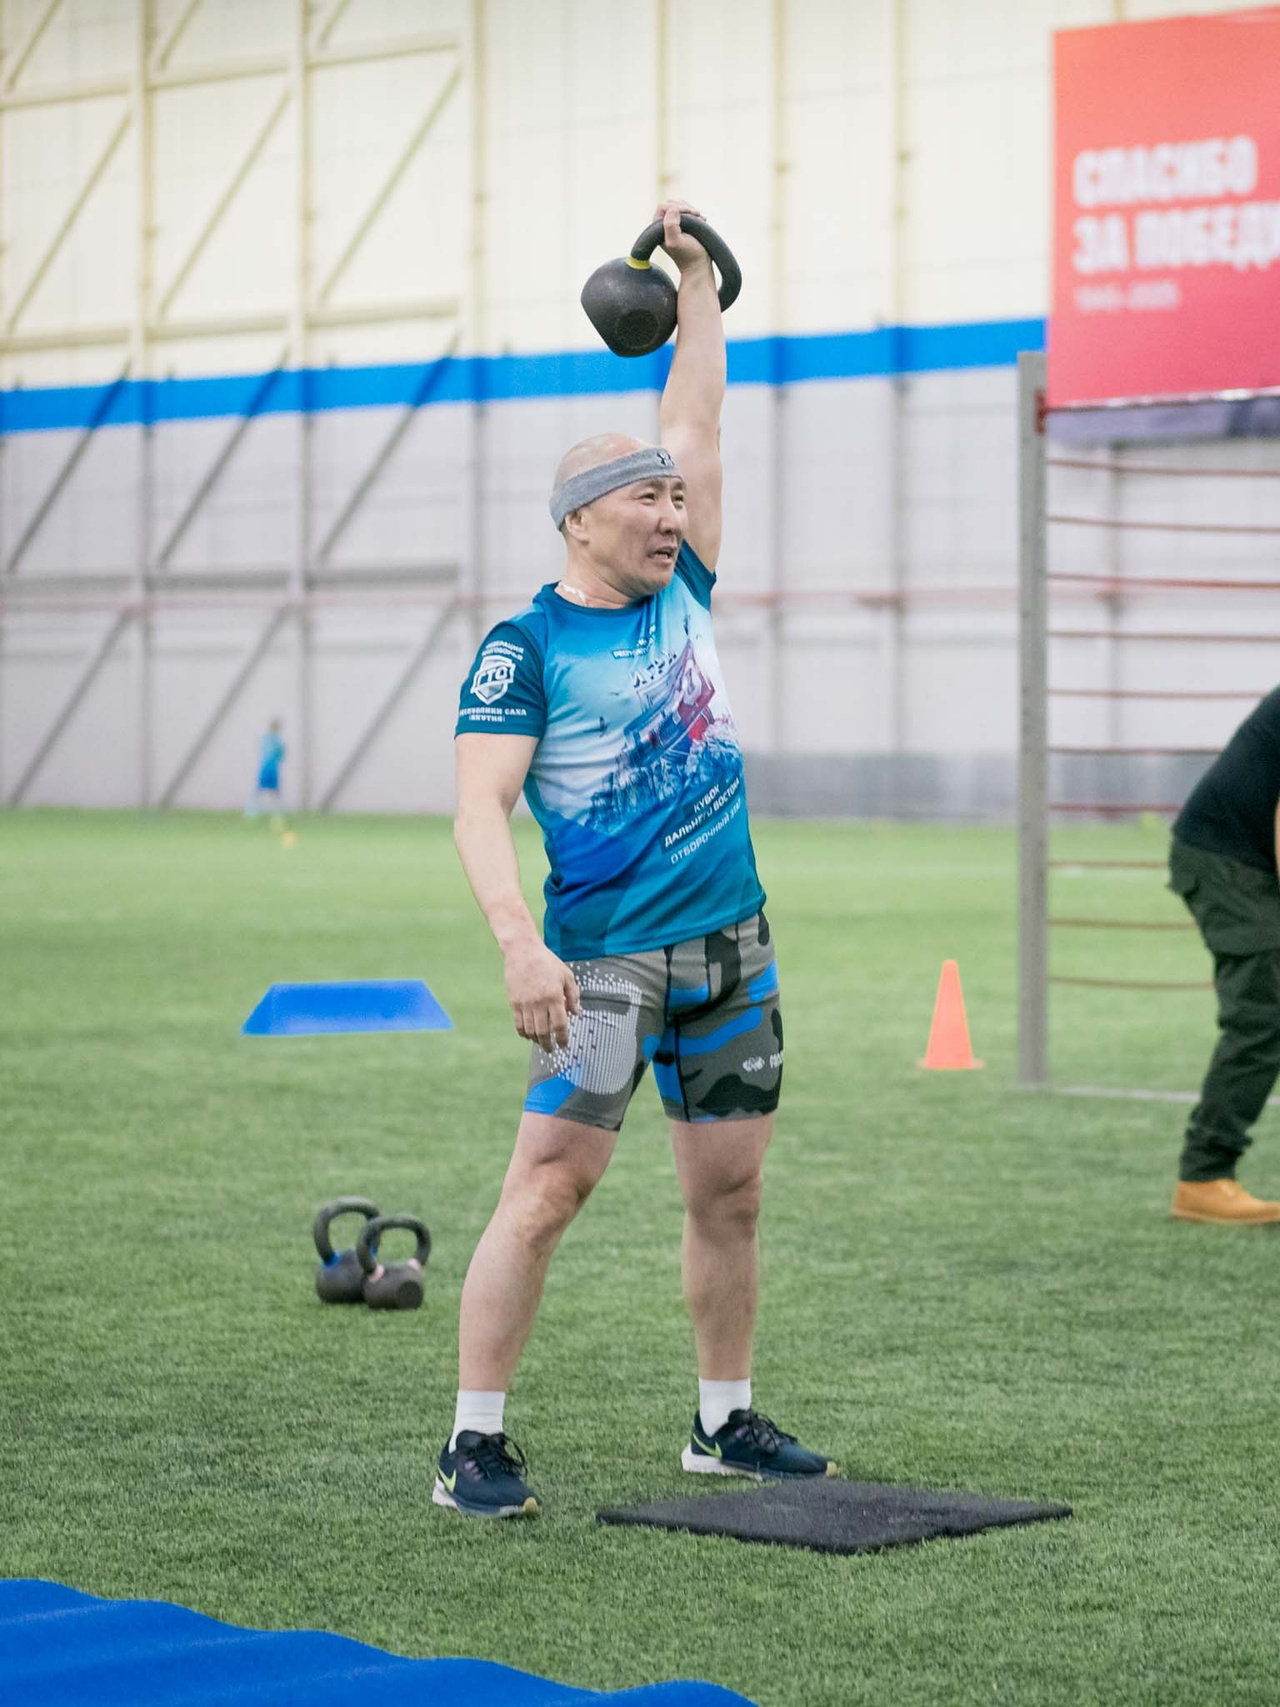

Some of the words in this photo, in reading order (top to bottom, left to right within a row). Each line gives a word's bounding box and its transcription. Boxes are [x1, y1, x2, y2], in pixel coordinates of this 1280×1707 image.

[1074, 135, 1258, 207] СПАСИБО
[1073, 215, 1130, 273] ЗА
[478, 666, 508, 686] ГТО
[504, 708, 527, 716] САХА
[693, 784, 720, 813] КУБОК
[670, 811, 730, 865] ОТБОРОЧНЫЙ
